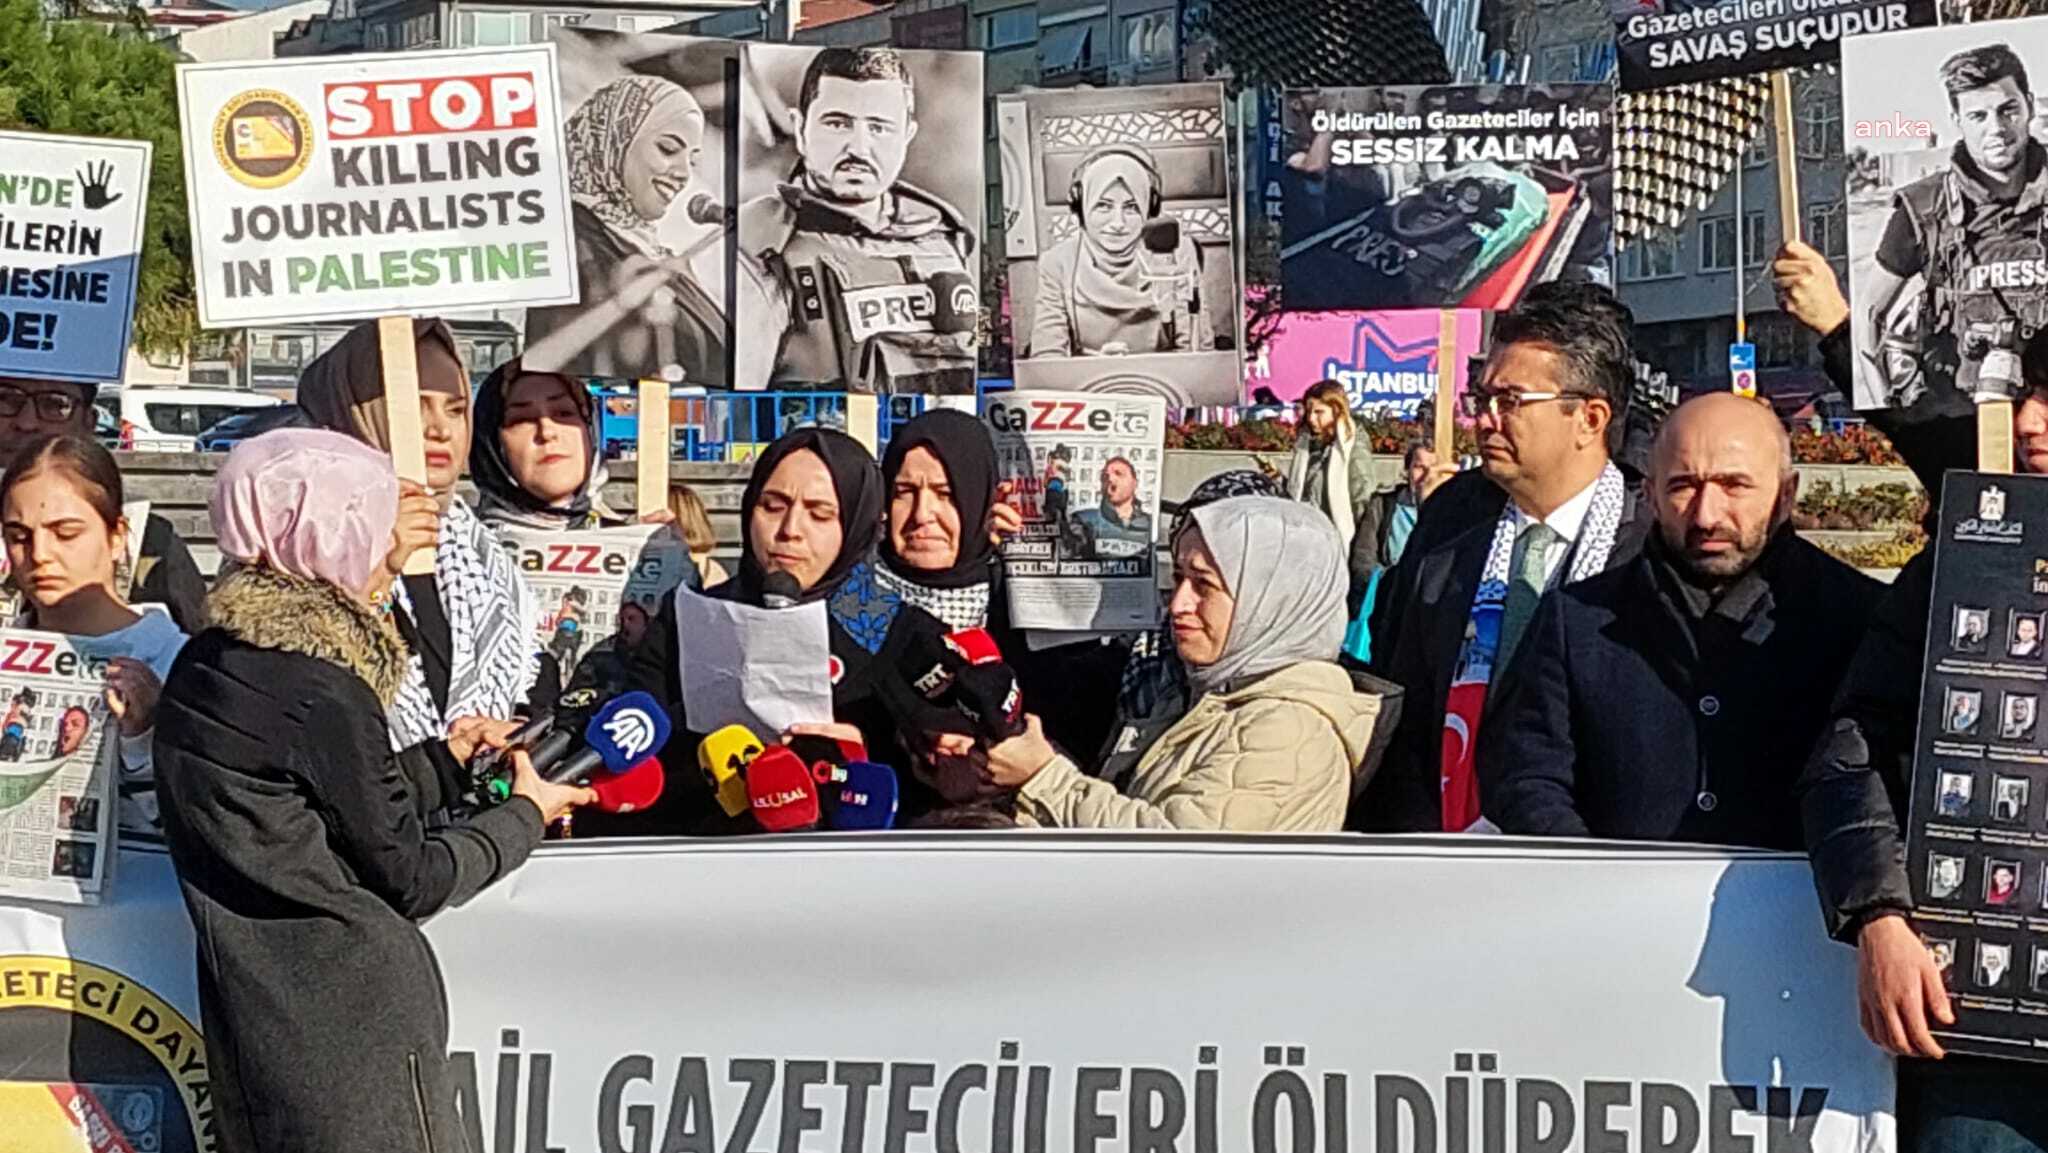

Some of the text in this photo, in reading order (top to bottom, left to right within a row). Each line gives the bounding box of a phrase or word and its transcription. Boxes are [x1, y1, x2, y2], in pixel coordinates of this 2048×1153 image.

[1628, 0, 1784, 39] Gazetecileri
[1650, 4, 1908, 67] SAVAŞ SUÇUDUR
[327, 76, 534, 136] STOP
[1311, 104, 1600, 132] Öldürülen Gazeteciler İçin
[331, 136, 541, 188] KILLING
[1456, 134, 1580, 163] KALMA
[222, 189, 546, 243] JOURNALISTS
[222, 241, 553, 298] IN PALESTINE
[0, 970, 125, 1015] ETECİ
[598, 1041, 1218, 1153] GAZETECİLERİ
